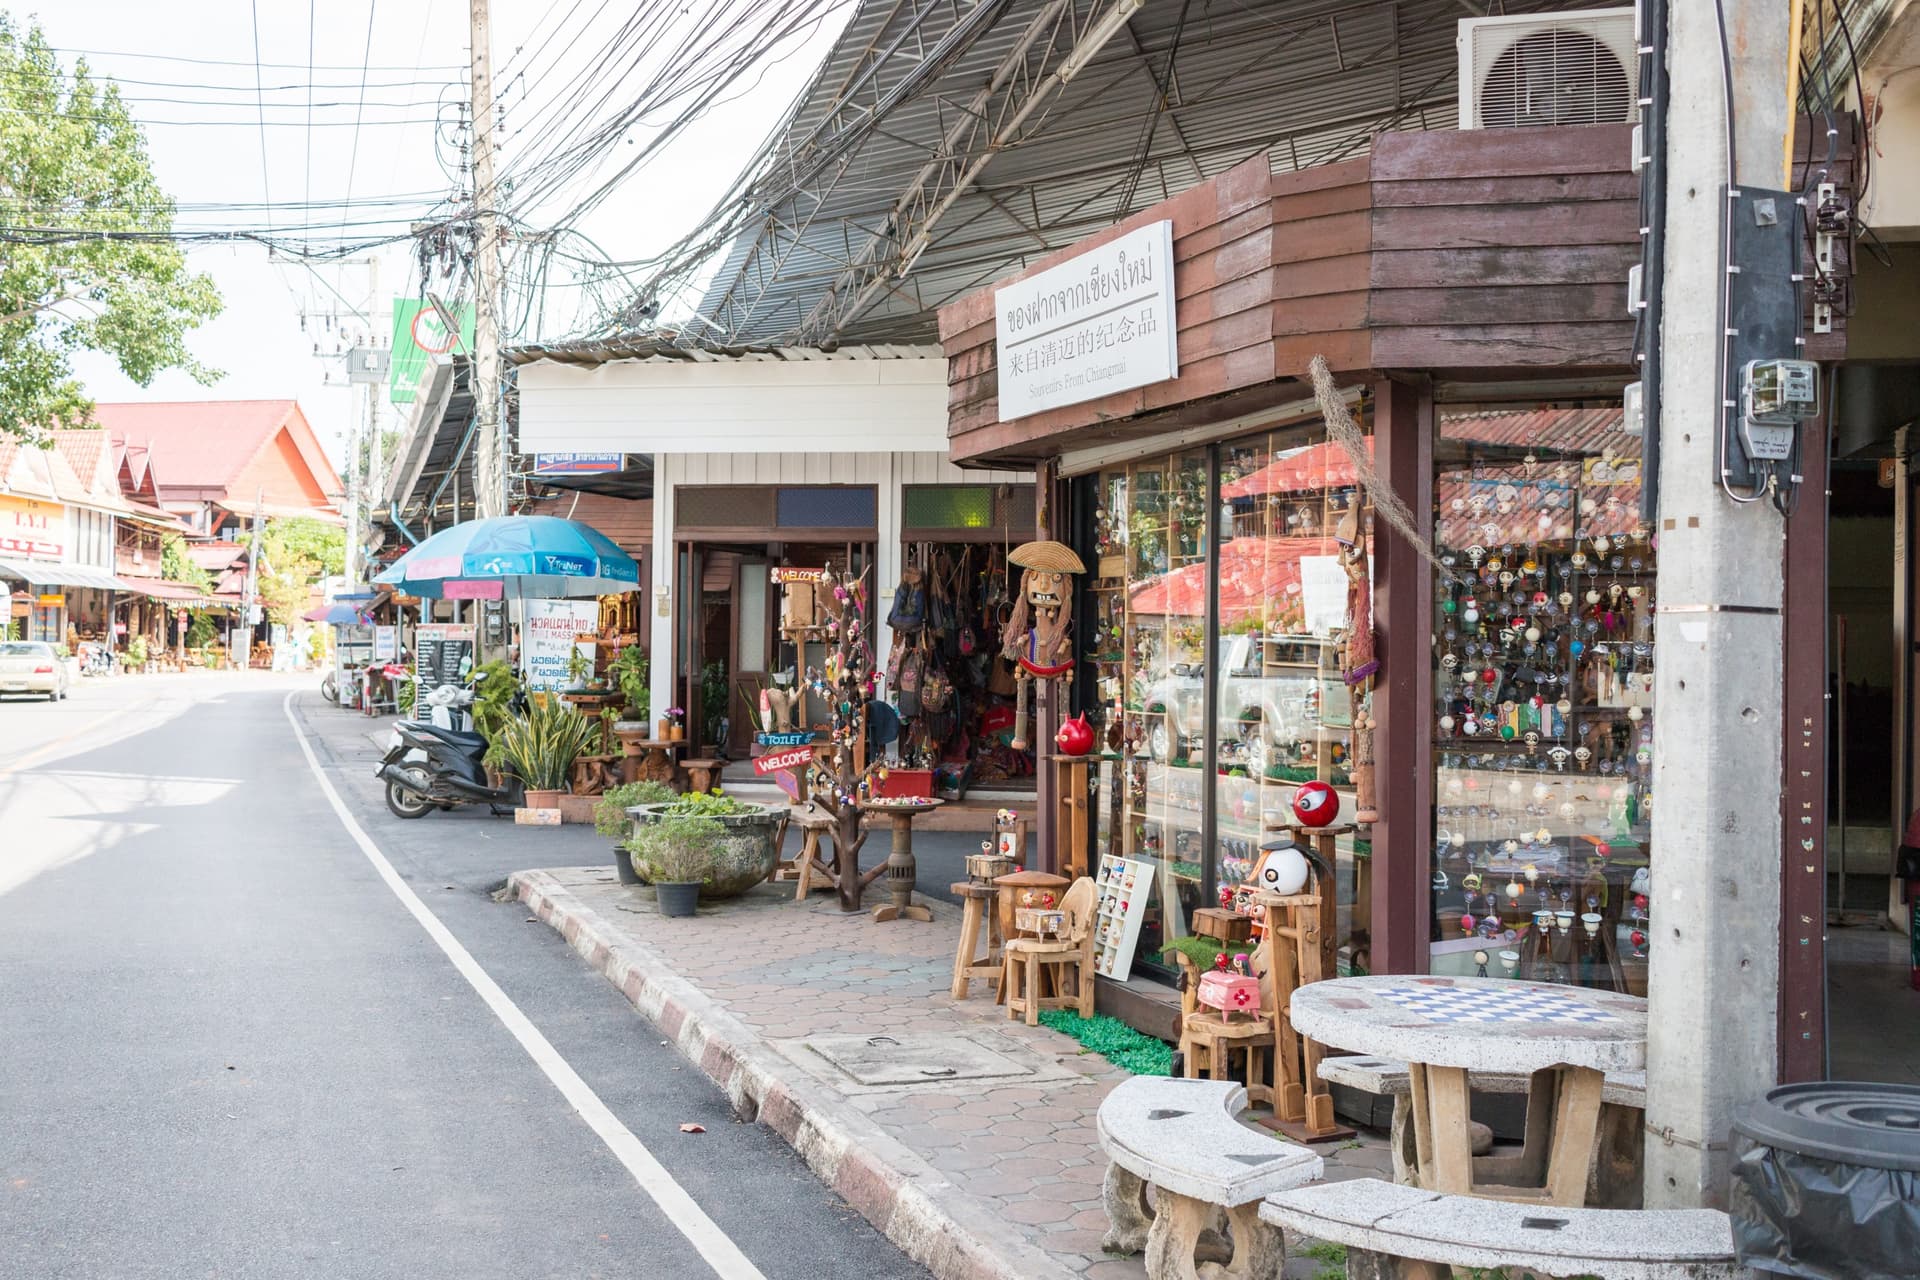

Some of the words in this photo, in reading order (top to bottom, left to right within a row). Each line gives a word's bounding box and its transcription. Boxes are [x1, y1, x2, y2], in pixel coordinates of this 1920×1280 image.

[1007, 241, 1153, 333] ของฝากจากเชียงใหม่
[1008, 307, 1157, 377] 来自清迈的纪念品
[1028, 379, 1064, 399] Souvenirs
[1064, 373, 1084, 390] From
[1085, 356, 1127, 384] Chiangmai
[781, 570, 822, 583] WELCOME
[767, 735, 802, 745] TOILET
[758, 749, 812, 772] WELCOME
